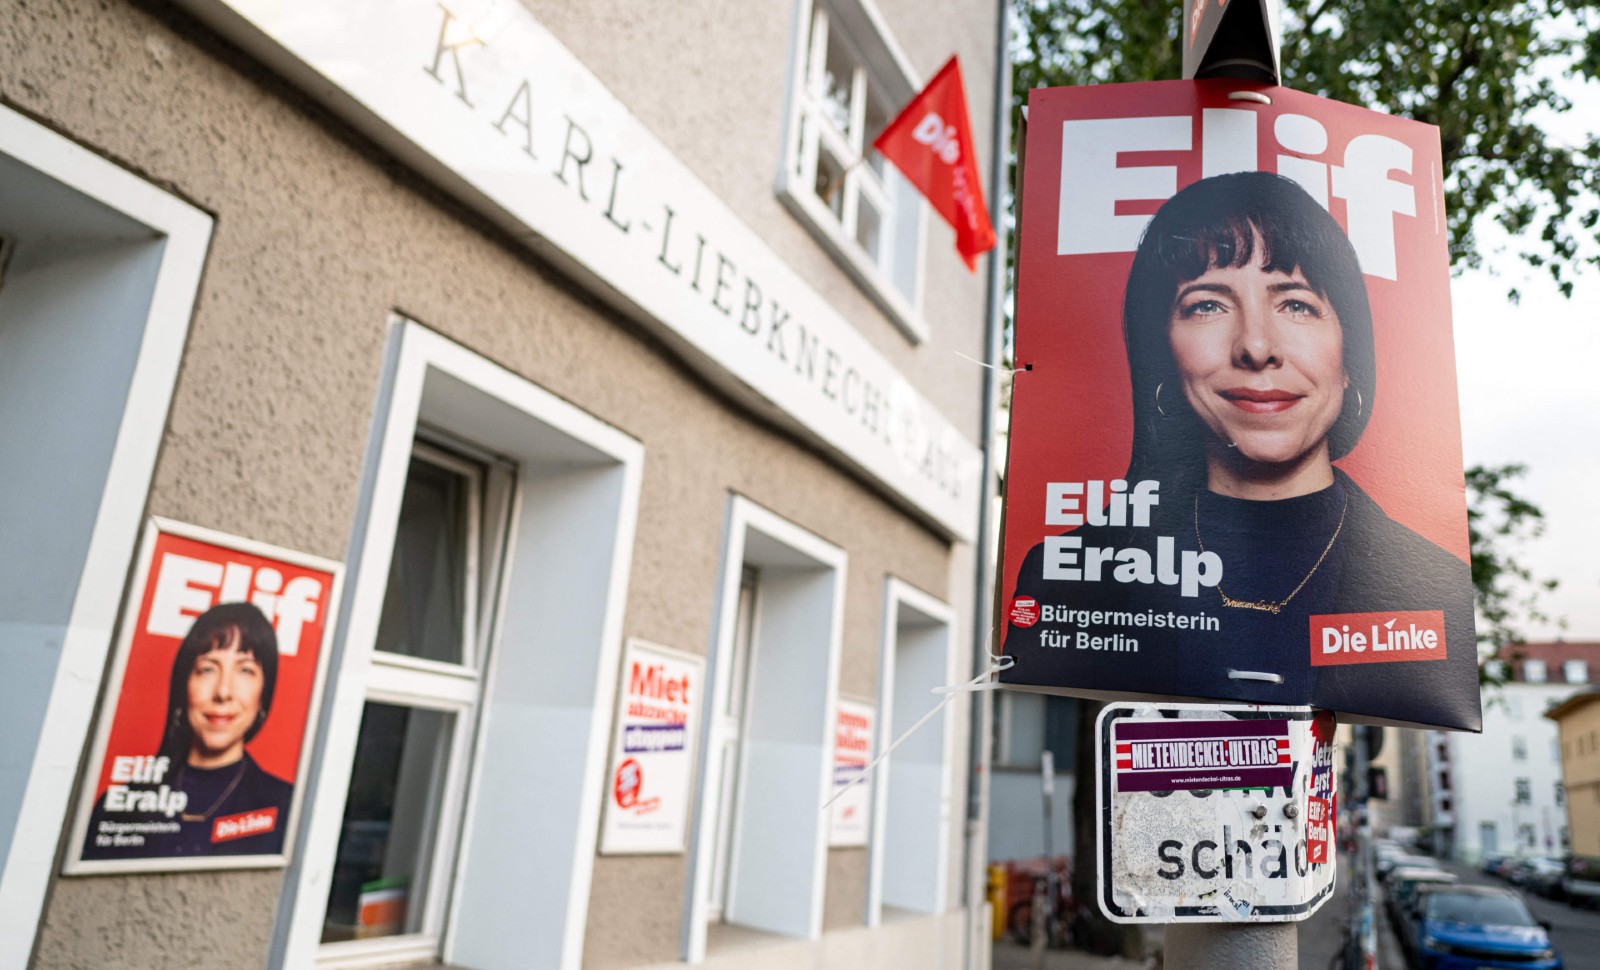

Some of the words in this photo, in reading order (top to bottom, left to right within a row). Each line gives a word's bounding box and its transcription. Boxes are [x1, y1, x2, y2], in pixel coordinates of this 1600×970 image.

[1045, 479, 1160, 527] Elif
[1042, 535, 1223, 597] Eralp
[1041, 604, 1220, 632] Bürgermeisterin
[1040, 630, 1073, 650] für
[1076, 633, 1139, 653] Berlin
[1322, 623, 1365, 655] Die
[1371, 617, 1438, 652] Linke
[629, 661, 689, 705] Miet
[111, 755, 171, 784] Elif
[1131, 739, 1278, 770] MIETENDECKEL-ULTRAS
[104, 785, 188, 818] Eralp
[1309, 822, 1327, 841] Berlin
